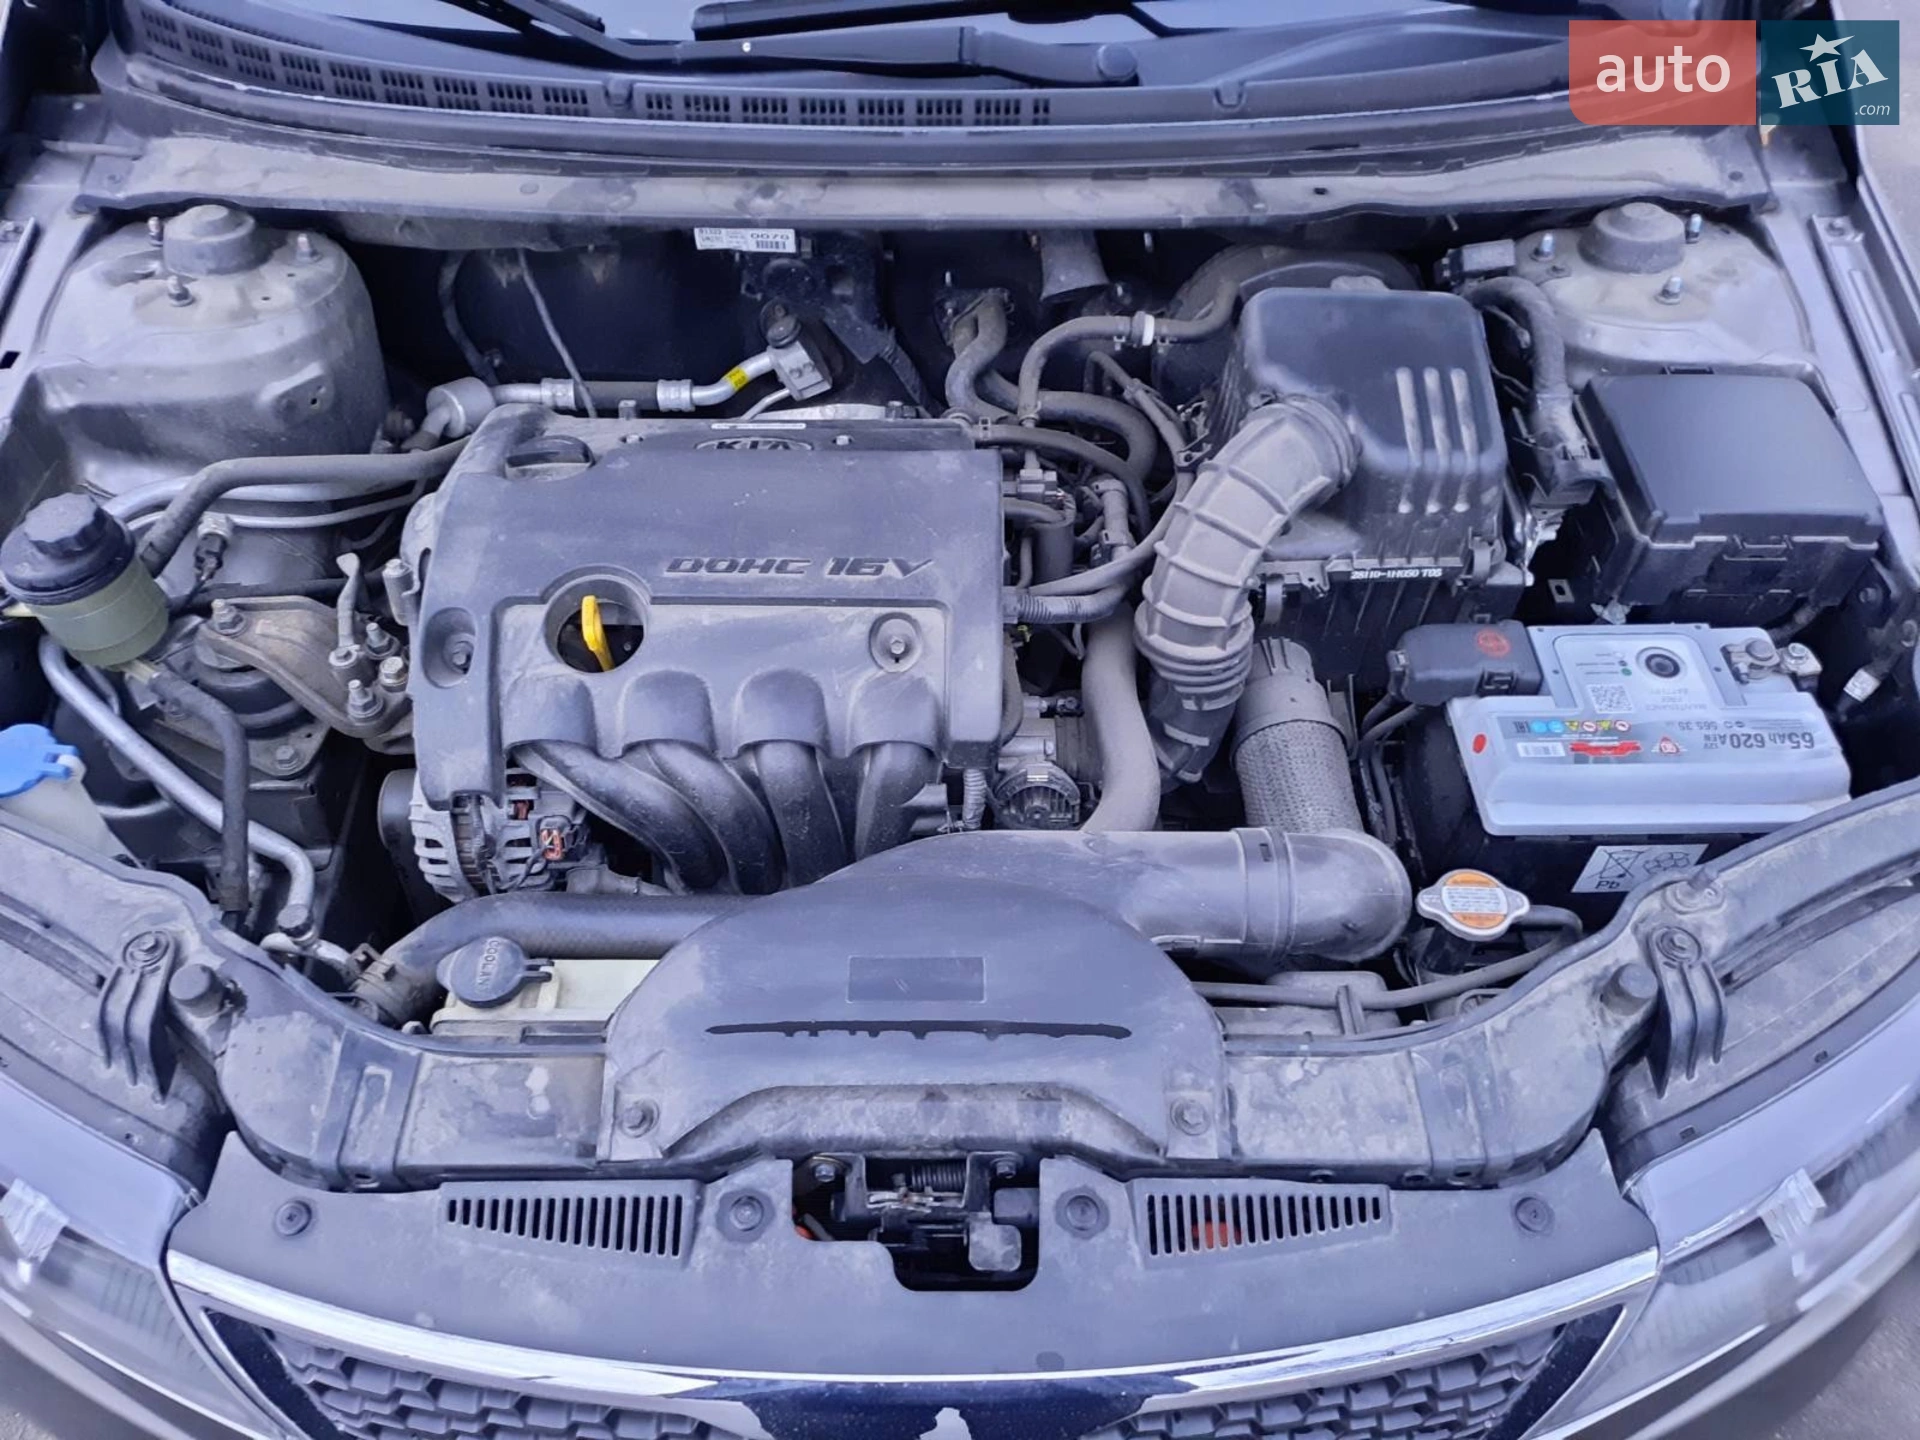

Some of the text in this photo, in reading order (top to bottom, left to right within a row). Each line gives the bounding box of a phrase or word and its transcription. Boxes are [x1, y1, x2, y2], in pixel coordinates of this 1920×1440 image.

[716, 440, 791, 450] KIA
[664, 556, 933, 577] DOHC 16V
[1768, 731, 1815, 749] 65Ah
[1595, 880, 1621, 889] Pb
[478, 940, 501, 988] COOLAN
